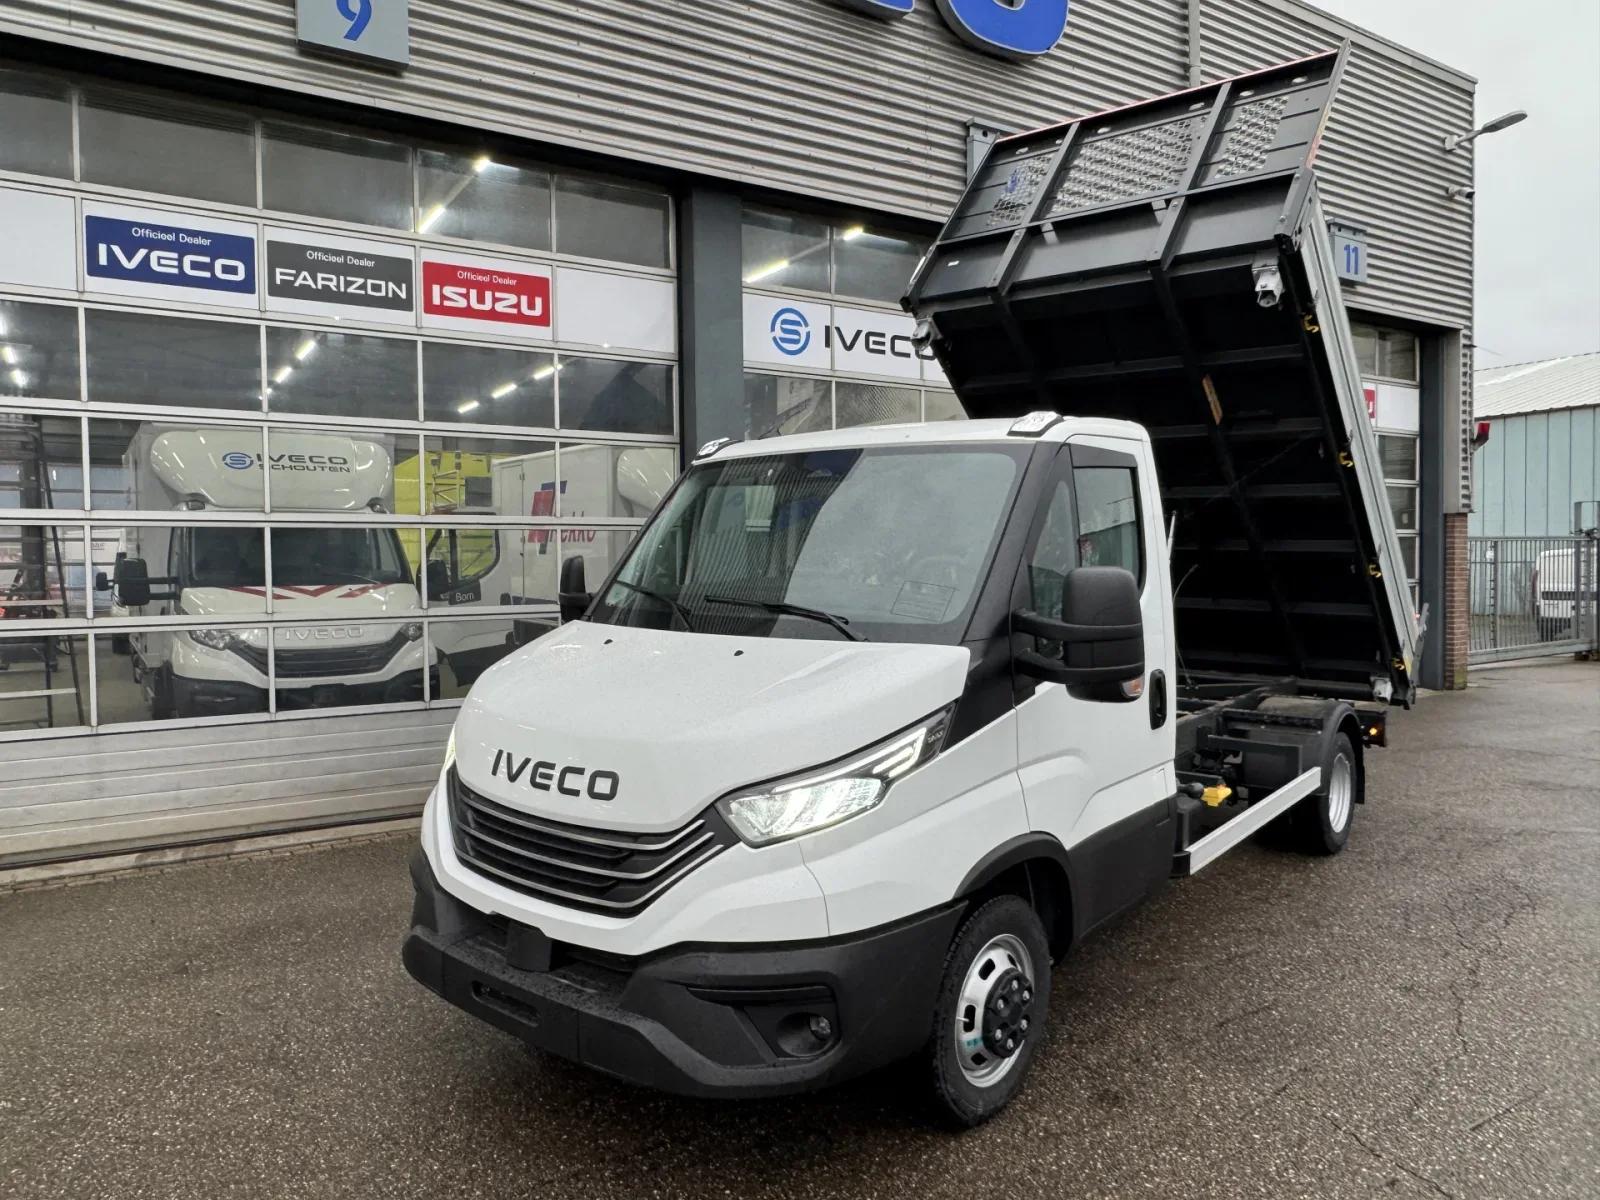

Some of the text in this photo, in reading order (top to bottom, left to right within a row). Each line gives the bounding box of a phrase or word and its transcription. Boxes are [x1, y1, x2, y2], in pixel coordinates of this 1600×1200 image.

[131, 227, 212, 246] Officieel Dealer
[98, 243, 246, 282] IVECO
[306, 250, 376, 267] Officieel Dealer
[1343, 244, 1359, 275] 11
[275, 267, 407, 300] FARIZON
[457, 270, 517, 286] Officieel Dealer
[432, 284, 543, 317] ISUZU
[256, 453, 349, 465] IVECO
[286, 626, 364, 641] IVECO
[491, 748, 620, 802] IVECO
